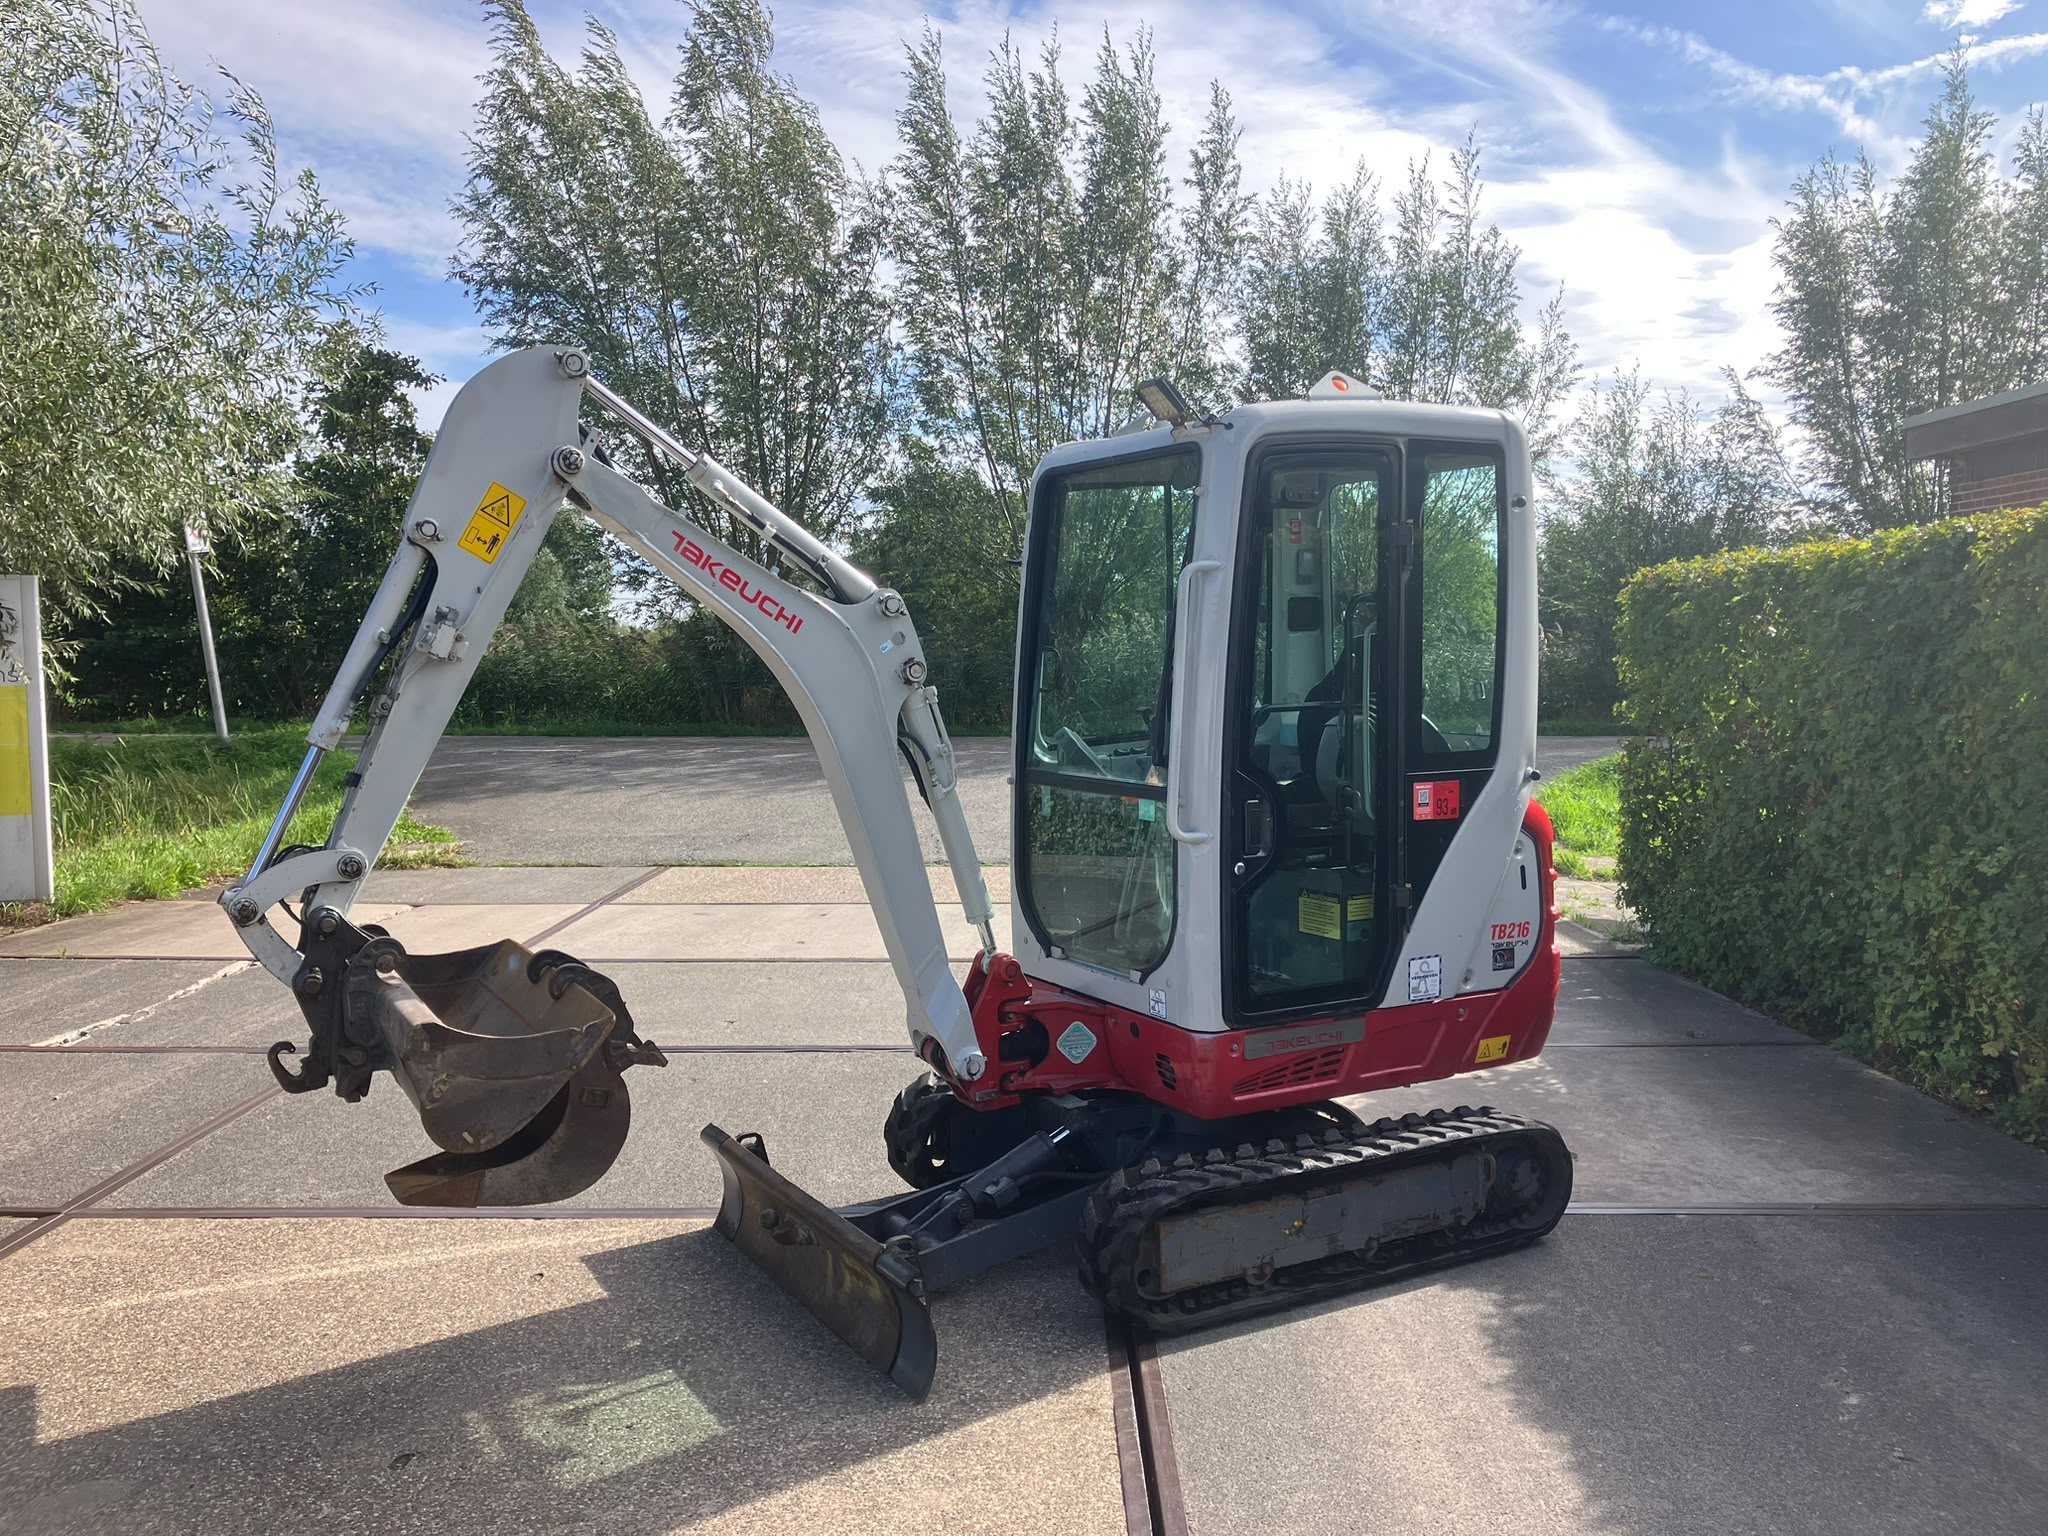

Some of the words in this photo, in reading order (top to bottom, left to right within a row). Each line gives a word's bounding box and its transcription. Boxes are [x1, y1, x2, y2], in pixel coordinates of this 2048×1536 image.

[671, 530, 804, 634] TAKEUCHI
[1436, 797, 1449, 816] 93
[1491, 921, 1530, 940] TB216
[1267, 1031, 1344, 1051] TAKEUCHI
